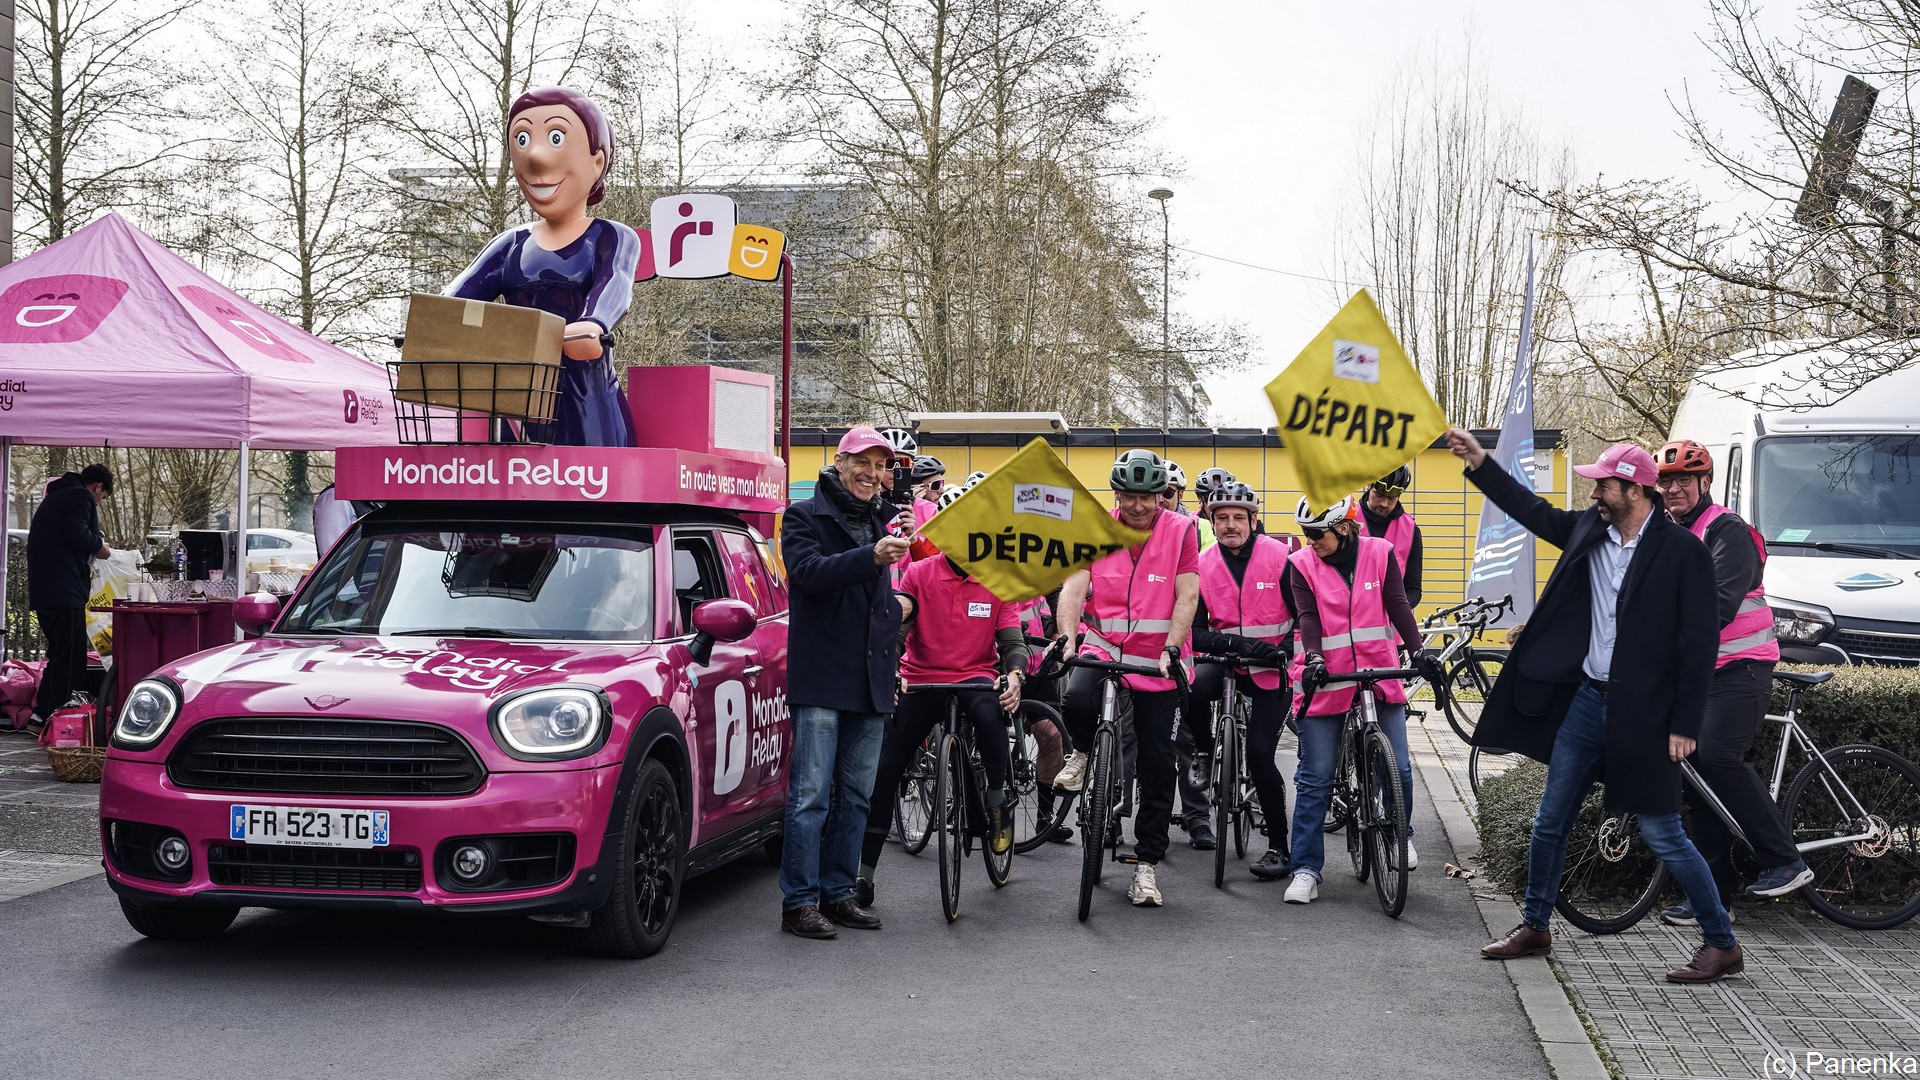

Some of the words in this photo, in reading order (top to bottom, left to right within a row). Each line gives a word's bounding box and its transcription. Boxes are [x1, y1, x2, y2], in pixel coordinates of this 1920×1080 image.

[360, 407, 378, 425] Relay
[1284, 387, 1416, 450] DÉPART
[384, 457, 500, 485] Mondial
[507, 457, 608, 499] Relay
[680, 464, 692, 489] En
[693, 470, 717, 492] route
[718, 474, 735, 495] vers
[736, 477, 754, 497] mon
[755, 476, 780, 500] Locker
[335, 651, 508, 690] Relay
[352, 646, 569, 675] Mondial
[751, 728, 783, 776] Relay
[249, 809, 277, 836] FR
[287, 811, 330, 838] 523
[341, 813, 369, 840] TG
[373, 830, 387, 842] 33
